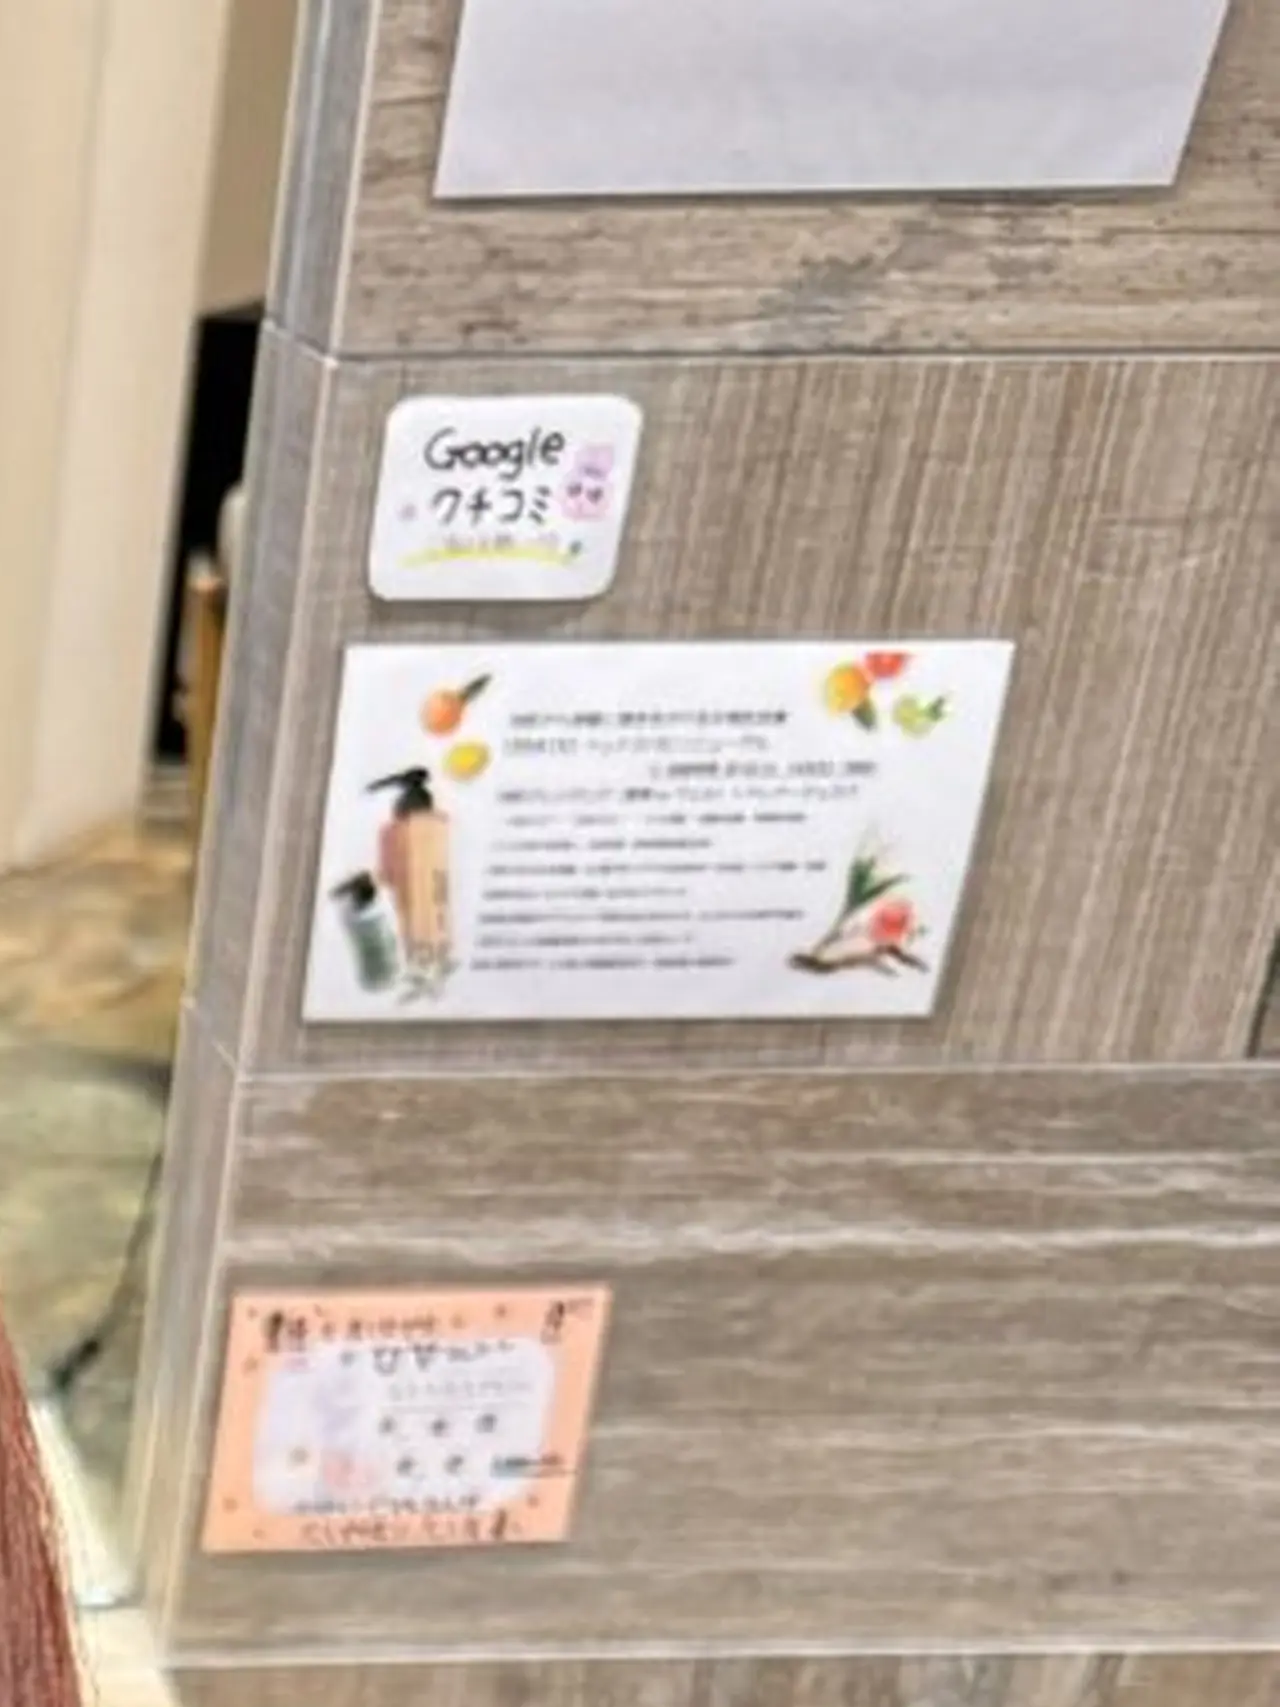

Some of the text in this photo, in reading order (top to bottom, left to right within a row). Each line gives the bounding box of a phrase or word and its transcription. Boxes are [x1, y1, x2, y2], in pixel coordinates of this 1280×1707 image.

[423, 427, 566, 481] Google
[431, 485, 552, 528] クチコミ
